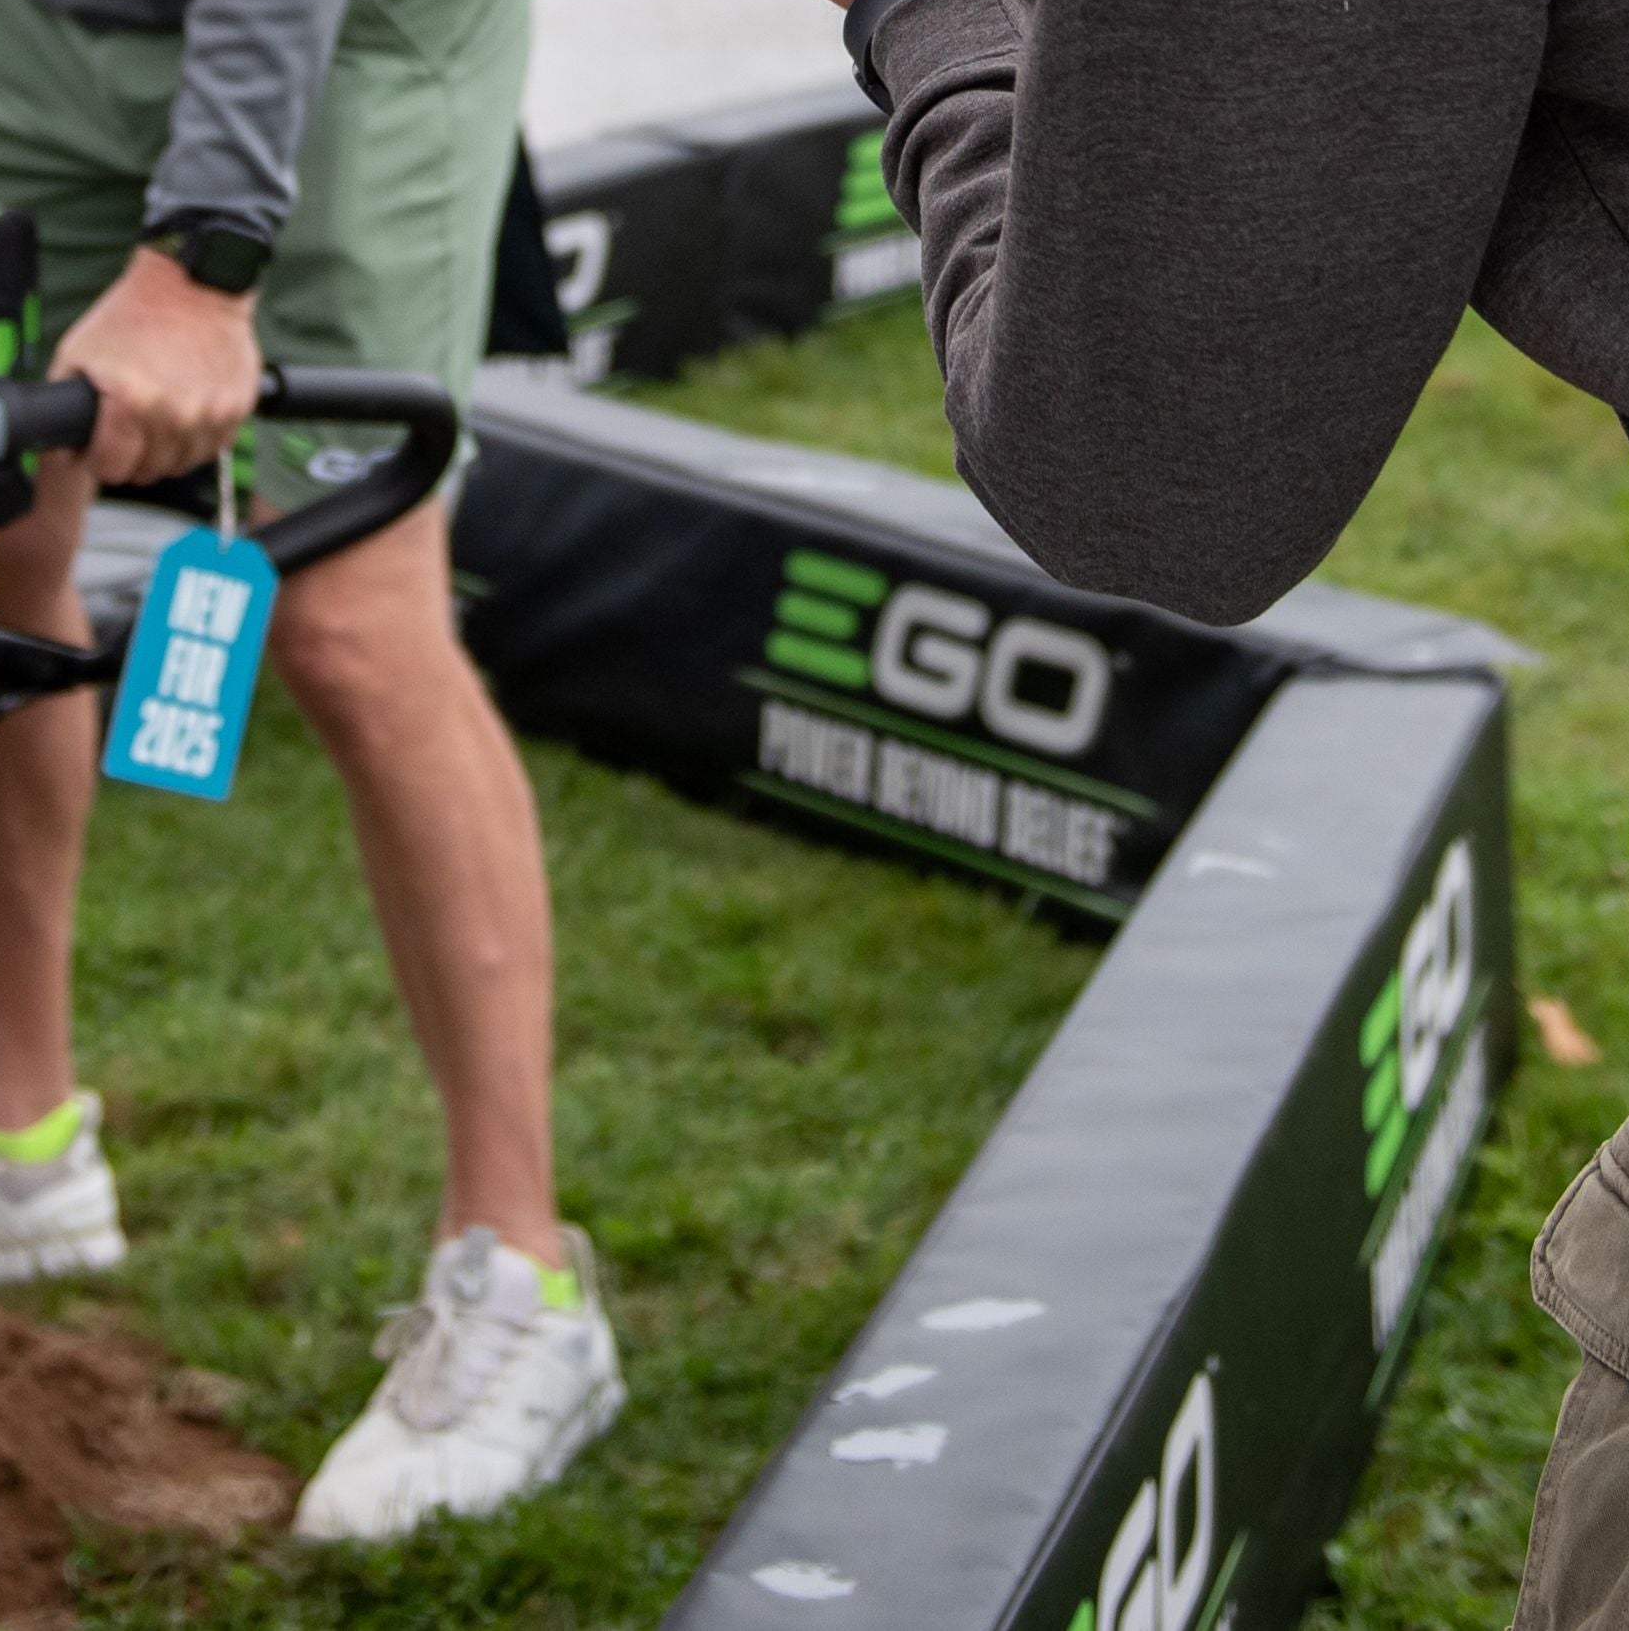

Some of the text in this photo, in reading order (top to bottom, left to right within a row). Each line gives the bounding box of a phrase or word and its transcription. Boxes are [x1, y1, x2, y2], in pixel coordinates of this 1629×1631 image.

[157, 634, 229, 708] FOR
[167, 565, 253, 645] NEW
[765, 548, 1113, 757] EGO
[129, 695, 225, 778] 2025
[1358, 834, 1474, 1199] EGO
[1066, 1370, 1215, 1631] GO
